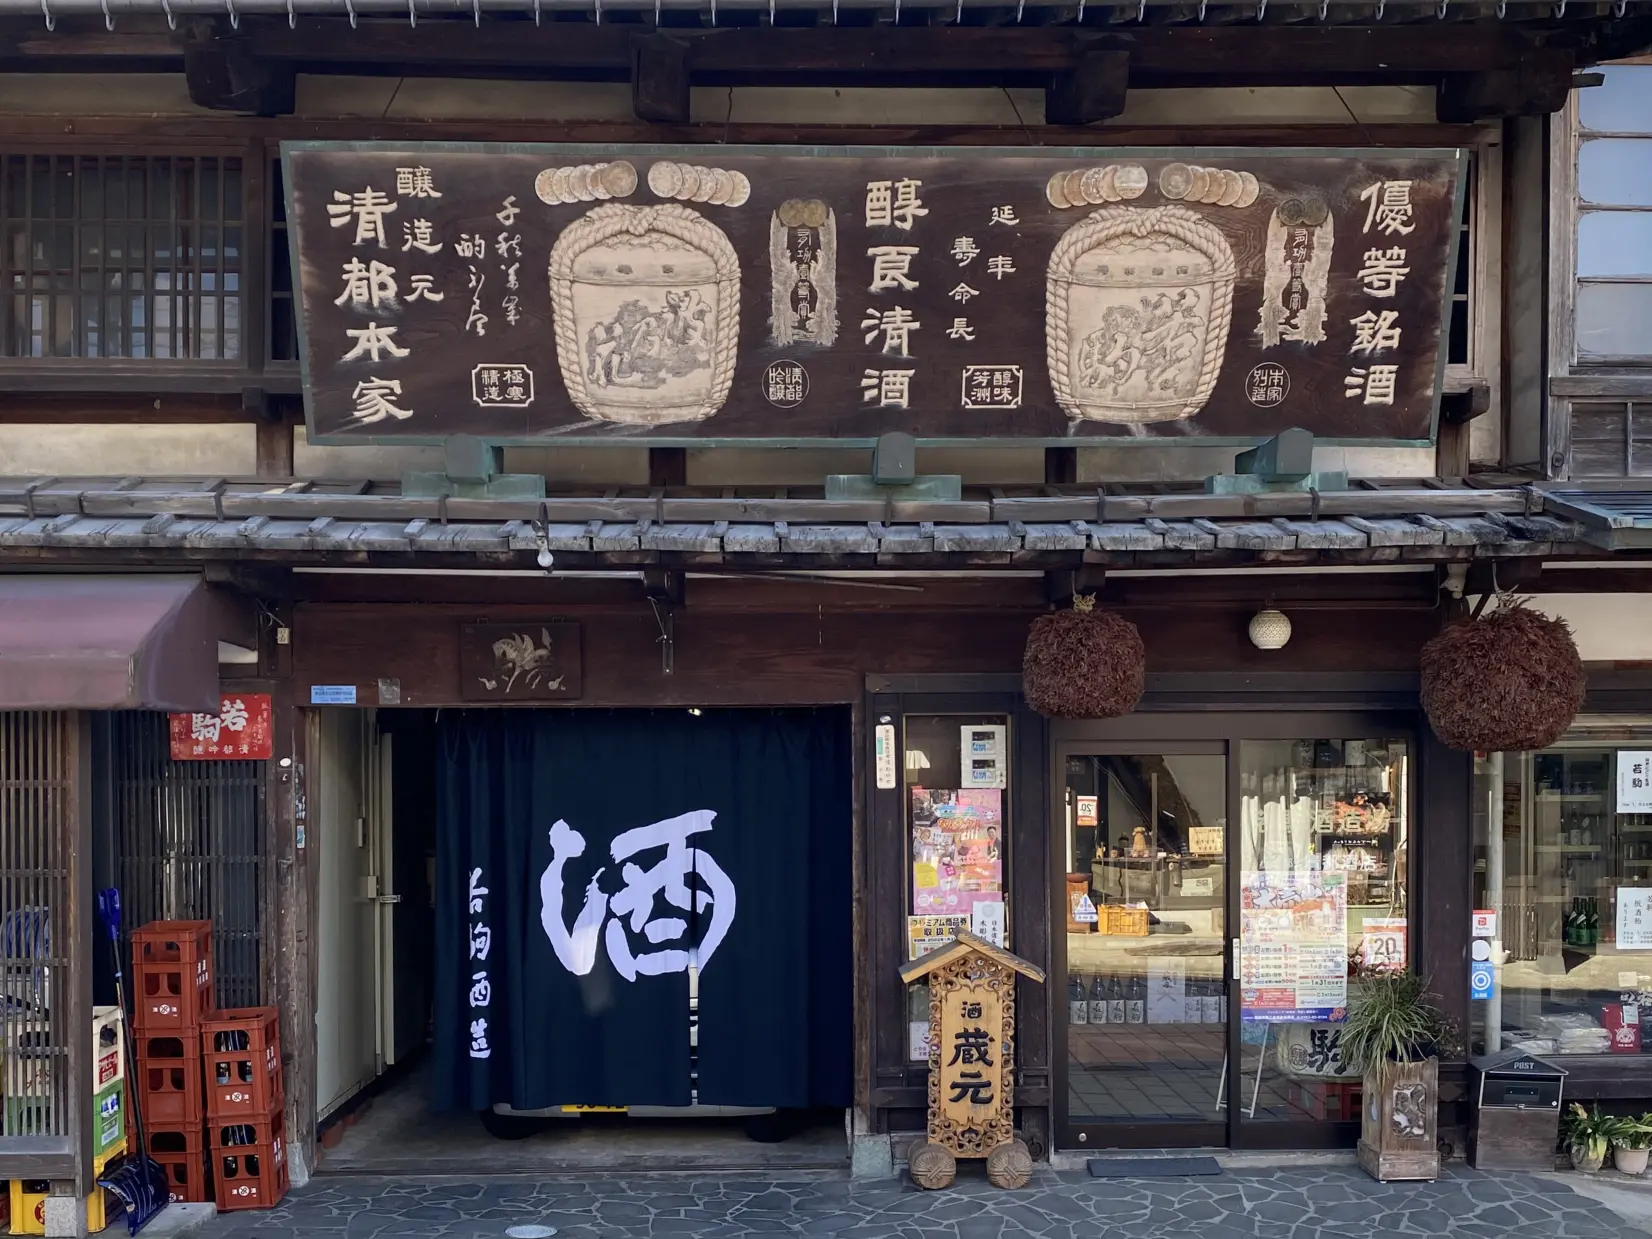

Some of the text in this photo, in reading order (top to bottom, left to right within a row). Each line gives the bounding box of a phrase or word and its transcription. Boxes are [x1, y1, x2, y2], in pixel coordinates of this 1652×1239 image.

[326, 186, 414, 424] 清都本家
[1344, 180, 1416, 406] 優等銘酒
[539, 808, 736, 982] 酒
[947, 1001, 996, 1105] 酒蔵元
[1514, 1062, 1535, 1070] POST
